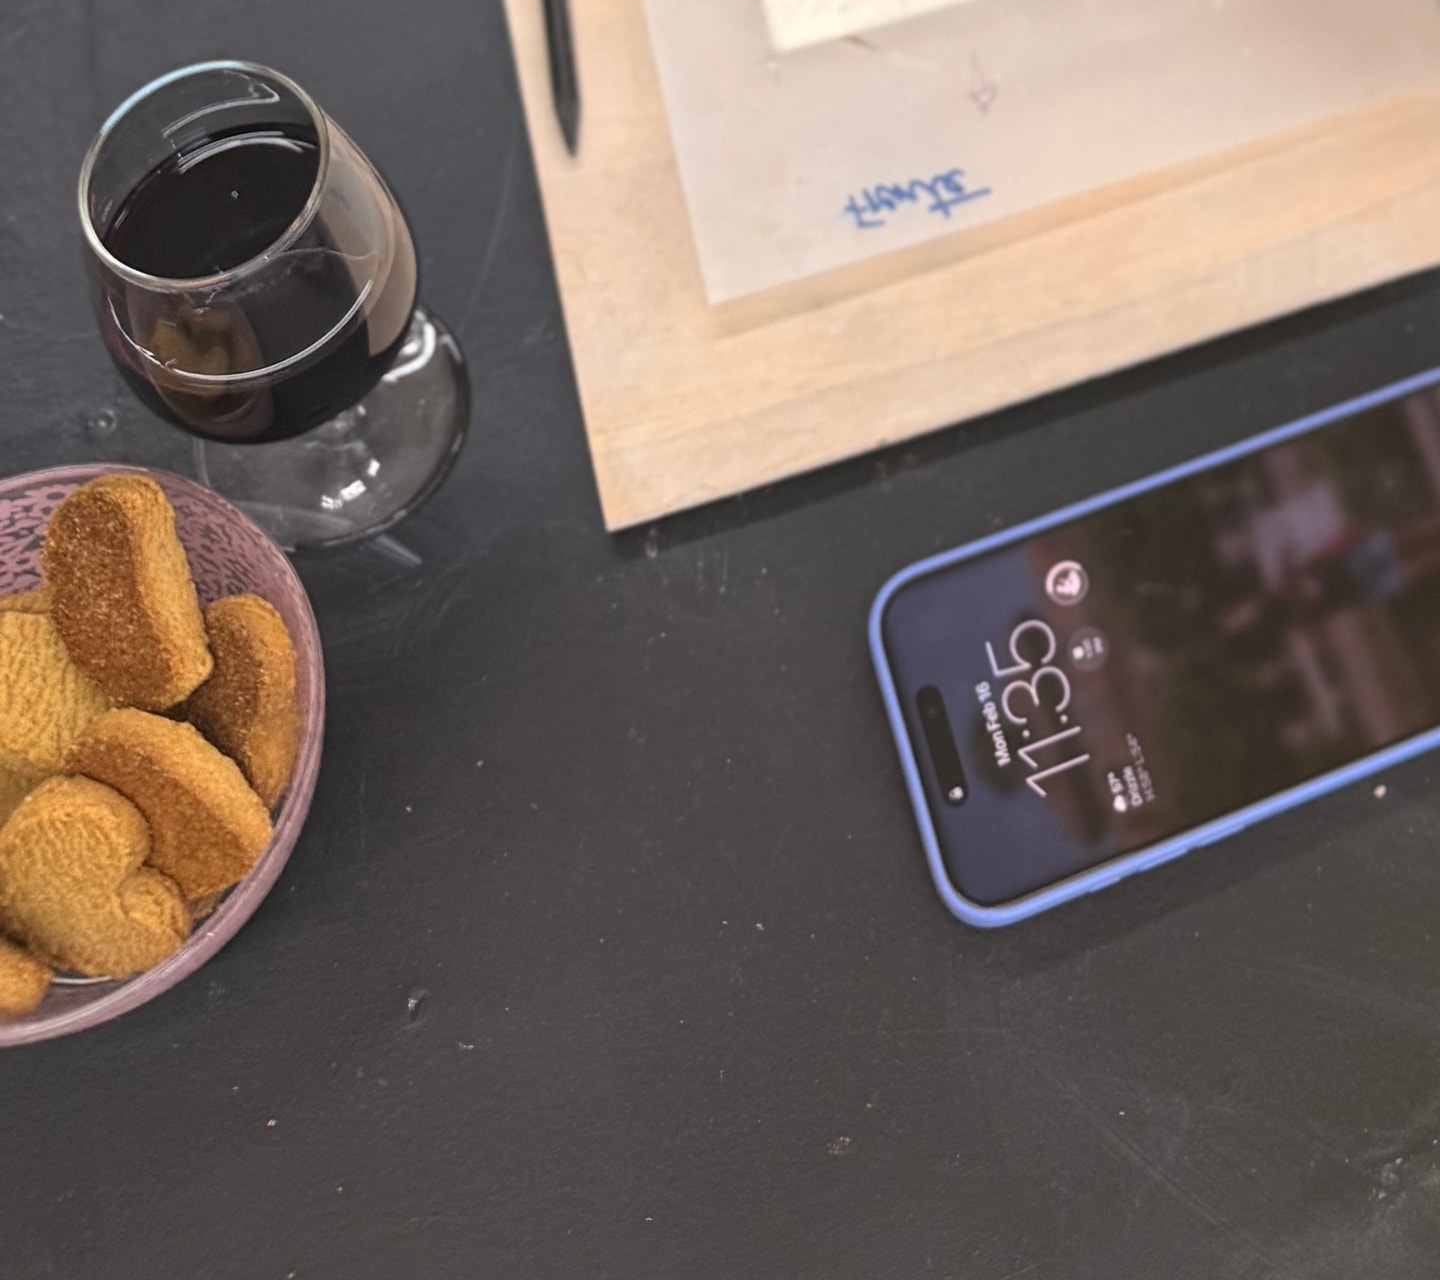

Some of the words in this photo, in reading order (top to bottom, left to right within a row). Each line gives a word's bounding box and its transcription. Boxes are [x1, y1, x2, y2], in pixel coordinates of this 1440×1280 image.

[975, 681, 992, 703] 16
[984, 619, 1090, 797] 11:35
[982, 701, 1001, 732] Feb
[992, 730, 1011, 767] Mon
[1123, 765, 1143, 807] Drizzle
